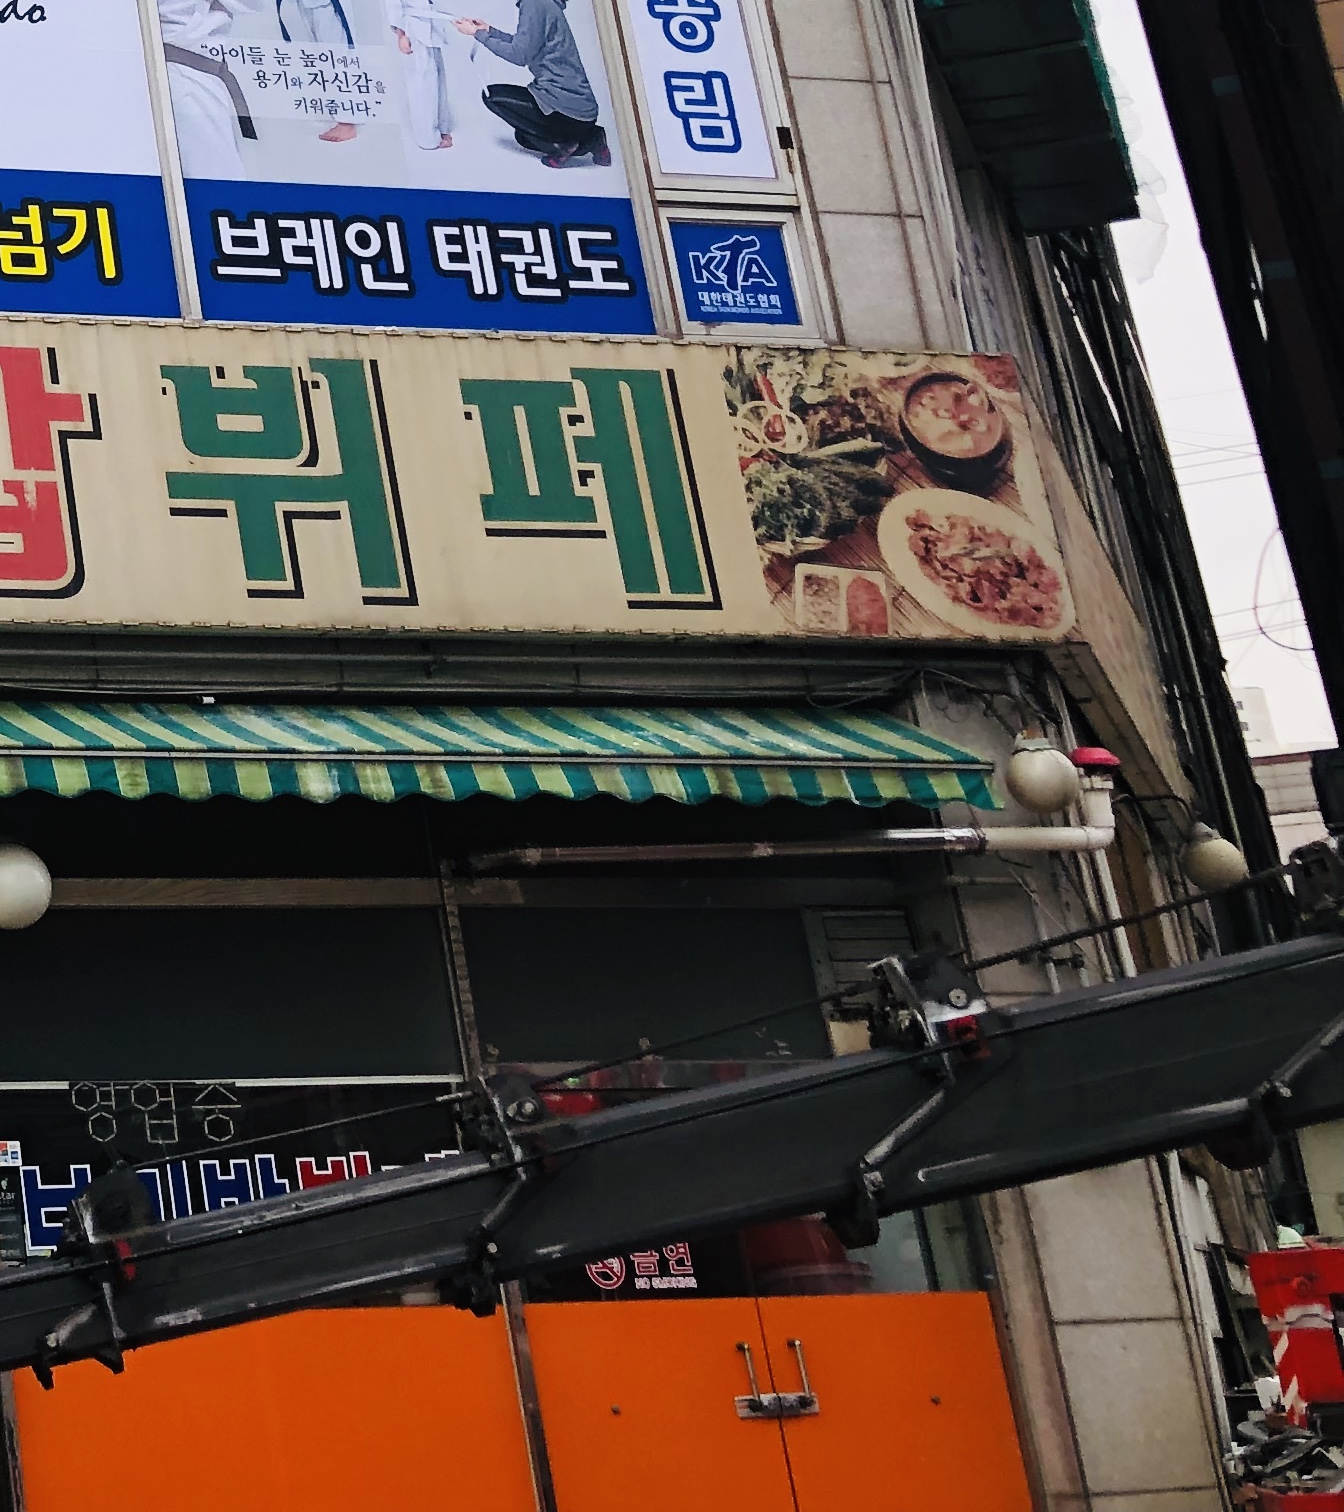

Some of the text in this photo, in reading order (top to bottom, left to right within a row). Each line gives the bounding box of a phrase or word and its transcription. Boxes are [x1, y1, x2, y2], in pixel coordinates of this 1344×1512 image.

[252, 69, 387, 95] 용기와 자신감을
[214, 212, 632, 300] 브레인 태권도
[689, 235, 777, 293] KTA
